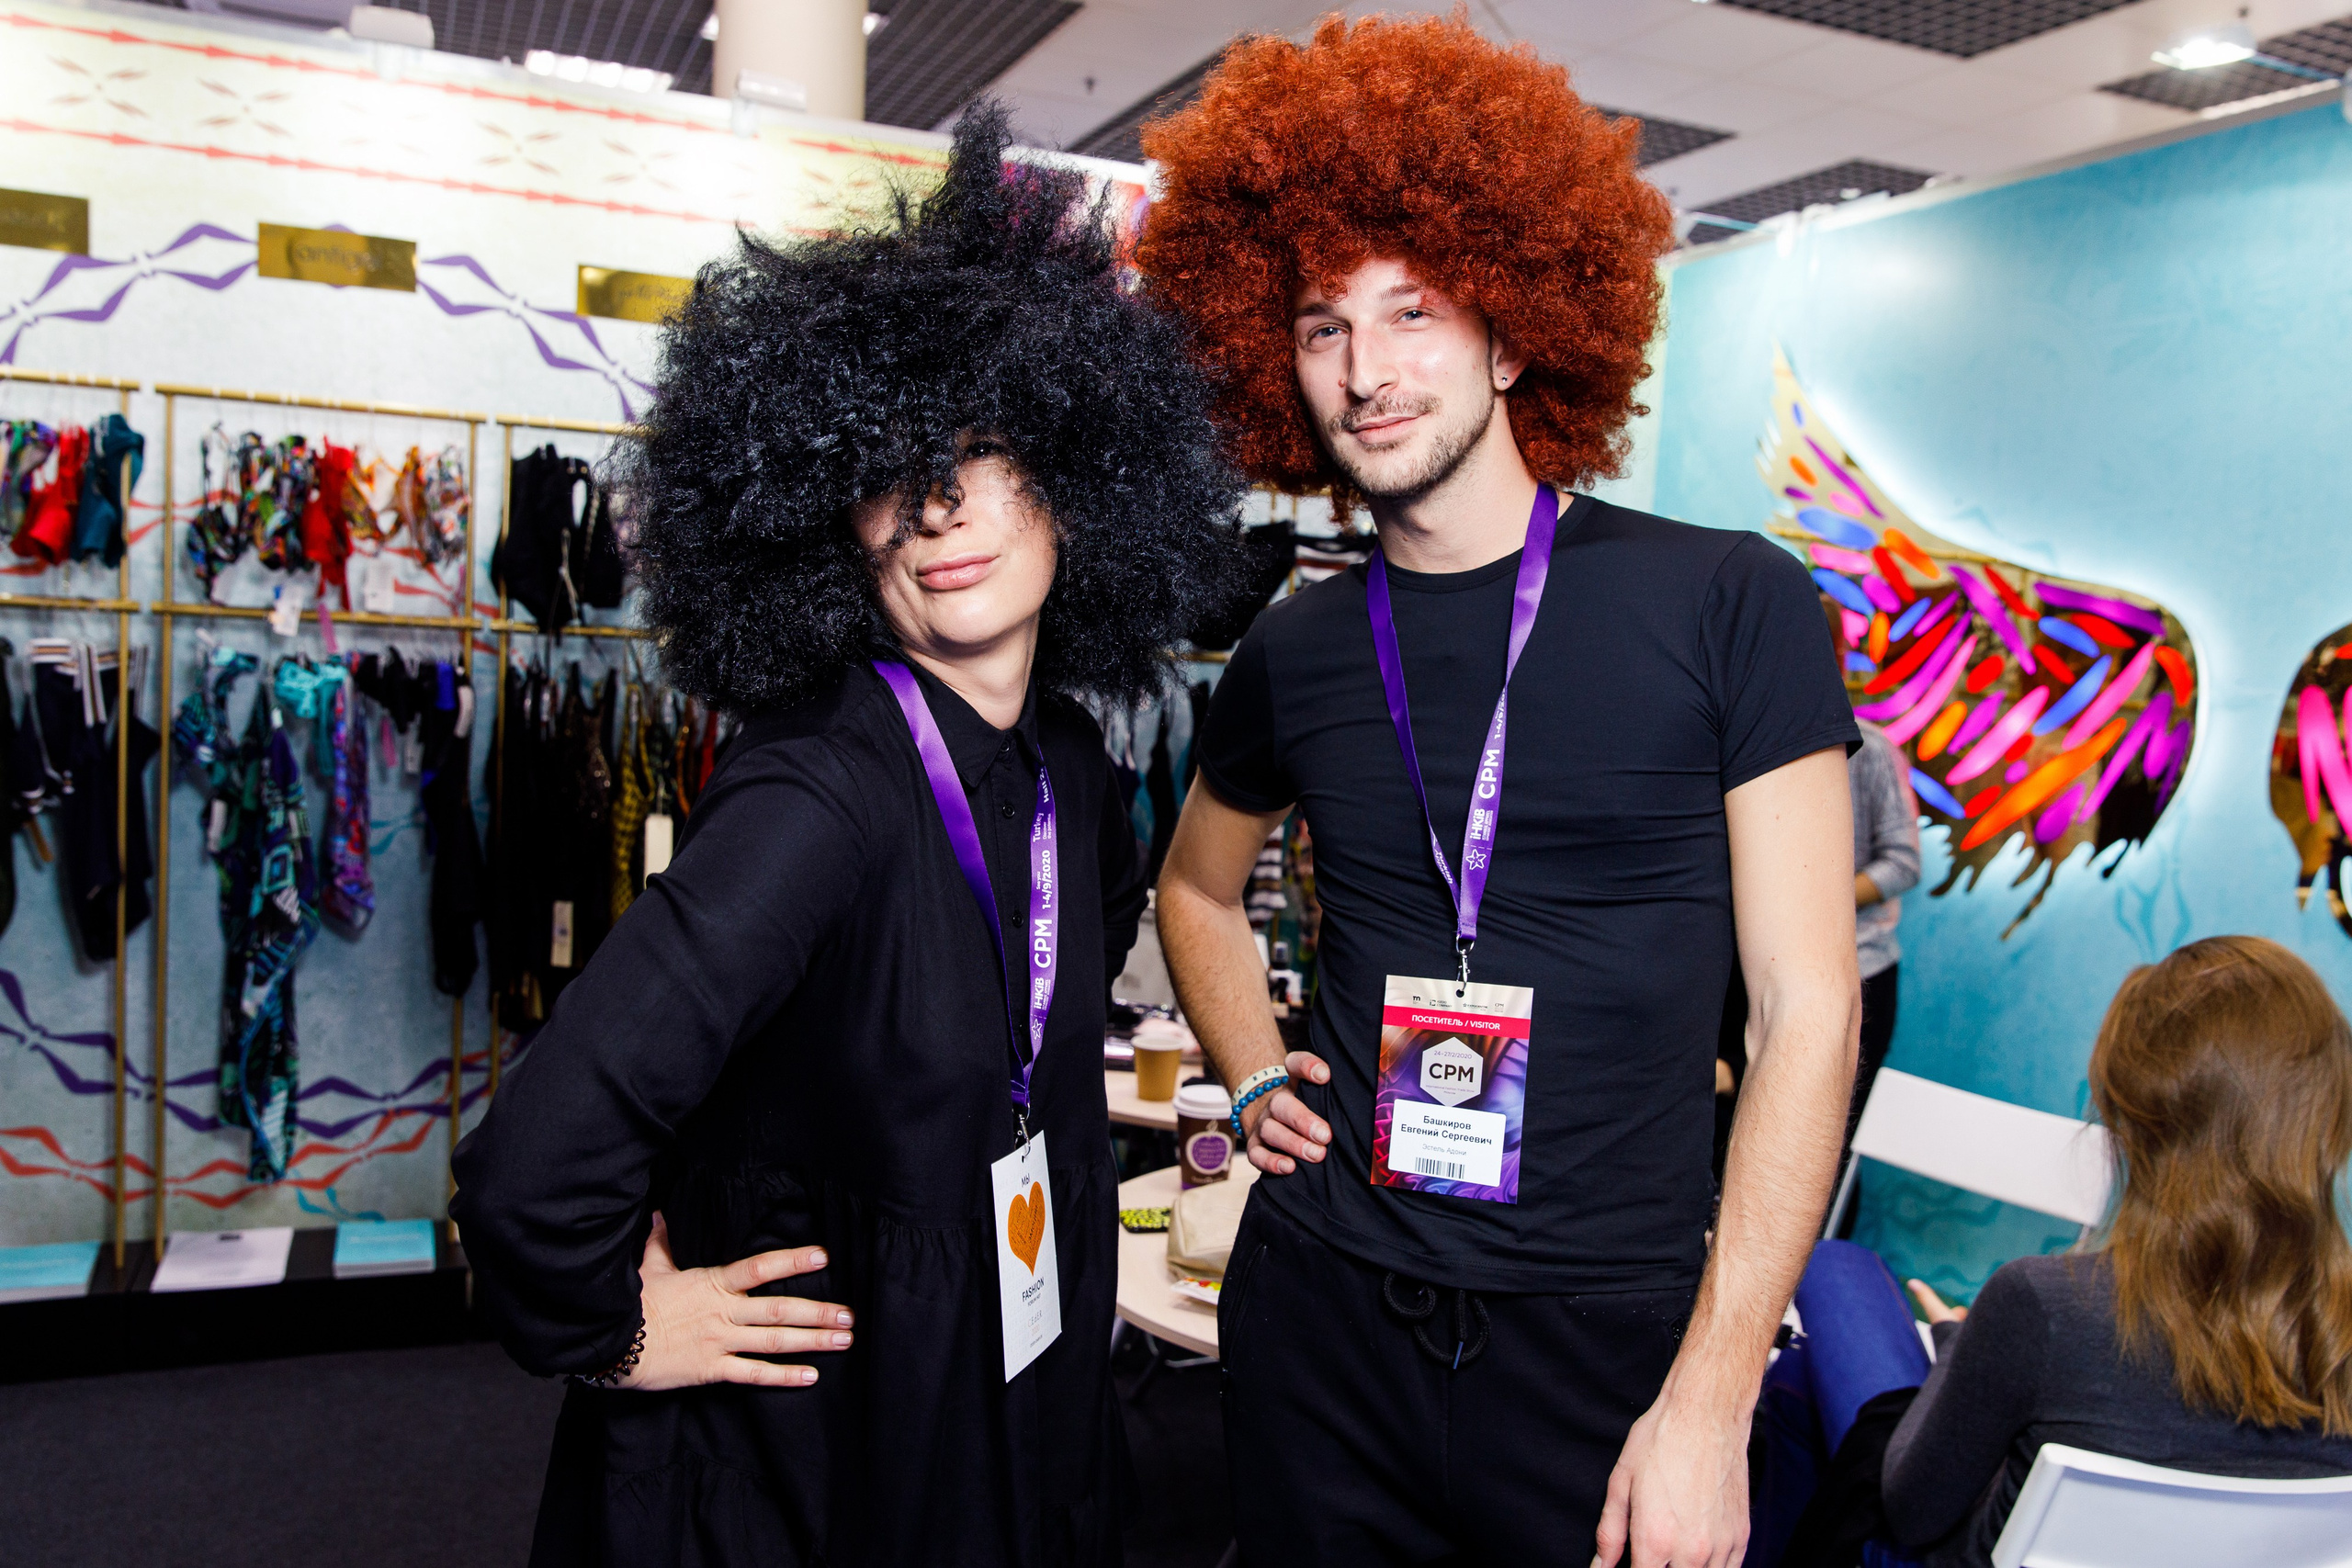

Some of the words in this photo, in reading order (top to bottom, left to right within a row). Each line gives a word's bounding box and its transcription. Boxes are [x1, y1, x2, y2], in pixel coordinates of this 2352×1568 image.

[1477, 749, 1500, 799] CPM
[1033, 812, 1045, 842] Turkey
[1041, 850, 1053, 909] 1-4/9/2020
[1034, 919, 1053, 968] CPM
[1411, 1014, 1464, 1027] ПОСЕТИТЕЛЬ
[1470, 1021, 1501, 1030] VISITOR
[1429, 1062, 1475, 1083] CPM
[1400, 1123, 1439, 1137] Евгений
[1442, 1130, 1492, 1145] Сергеевич
[1423, 1115, 1472, 1130] Башкиров
[1422, 1143, 1445, 1153] Эстель
[1022, 1276, 1045, 1303] FASHION
